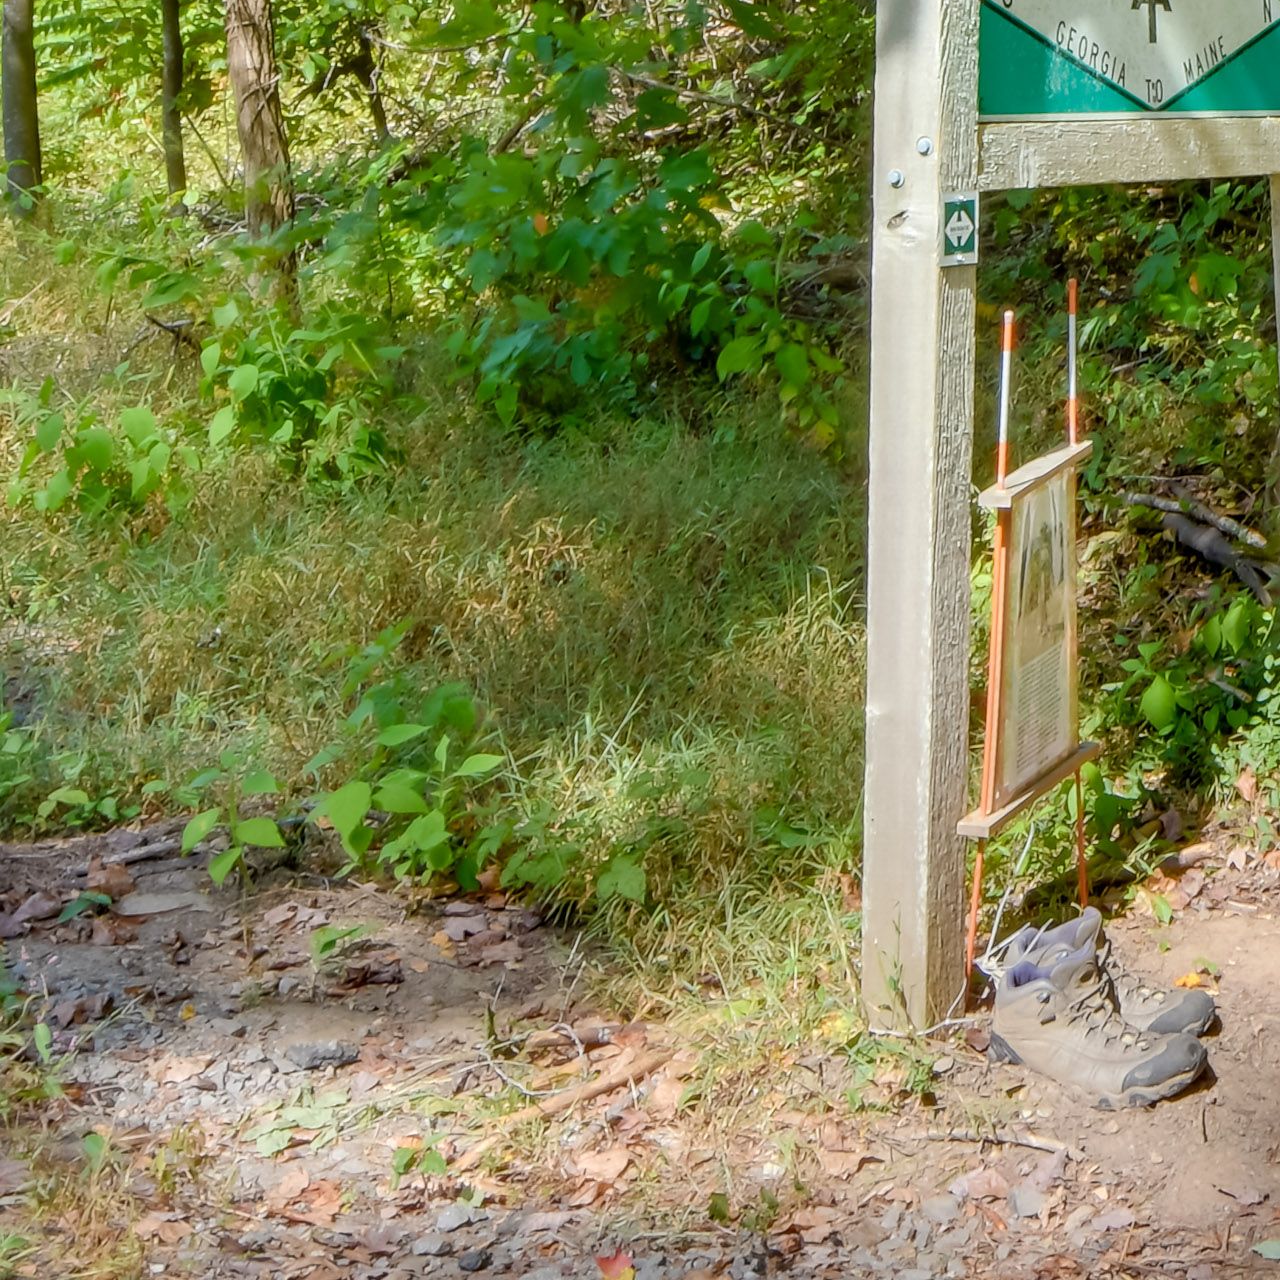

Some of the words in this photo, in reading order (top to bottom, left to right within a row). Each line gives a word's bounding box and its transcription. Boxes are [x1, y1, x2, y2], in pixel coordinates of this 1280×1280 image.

[1056, 20, 1126, 87] GEORGIA
[1145, 78, 1164, 103] TO
[1183, 35, 1227, 84] MAINE
